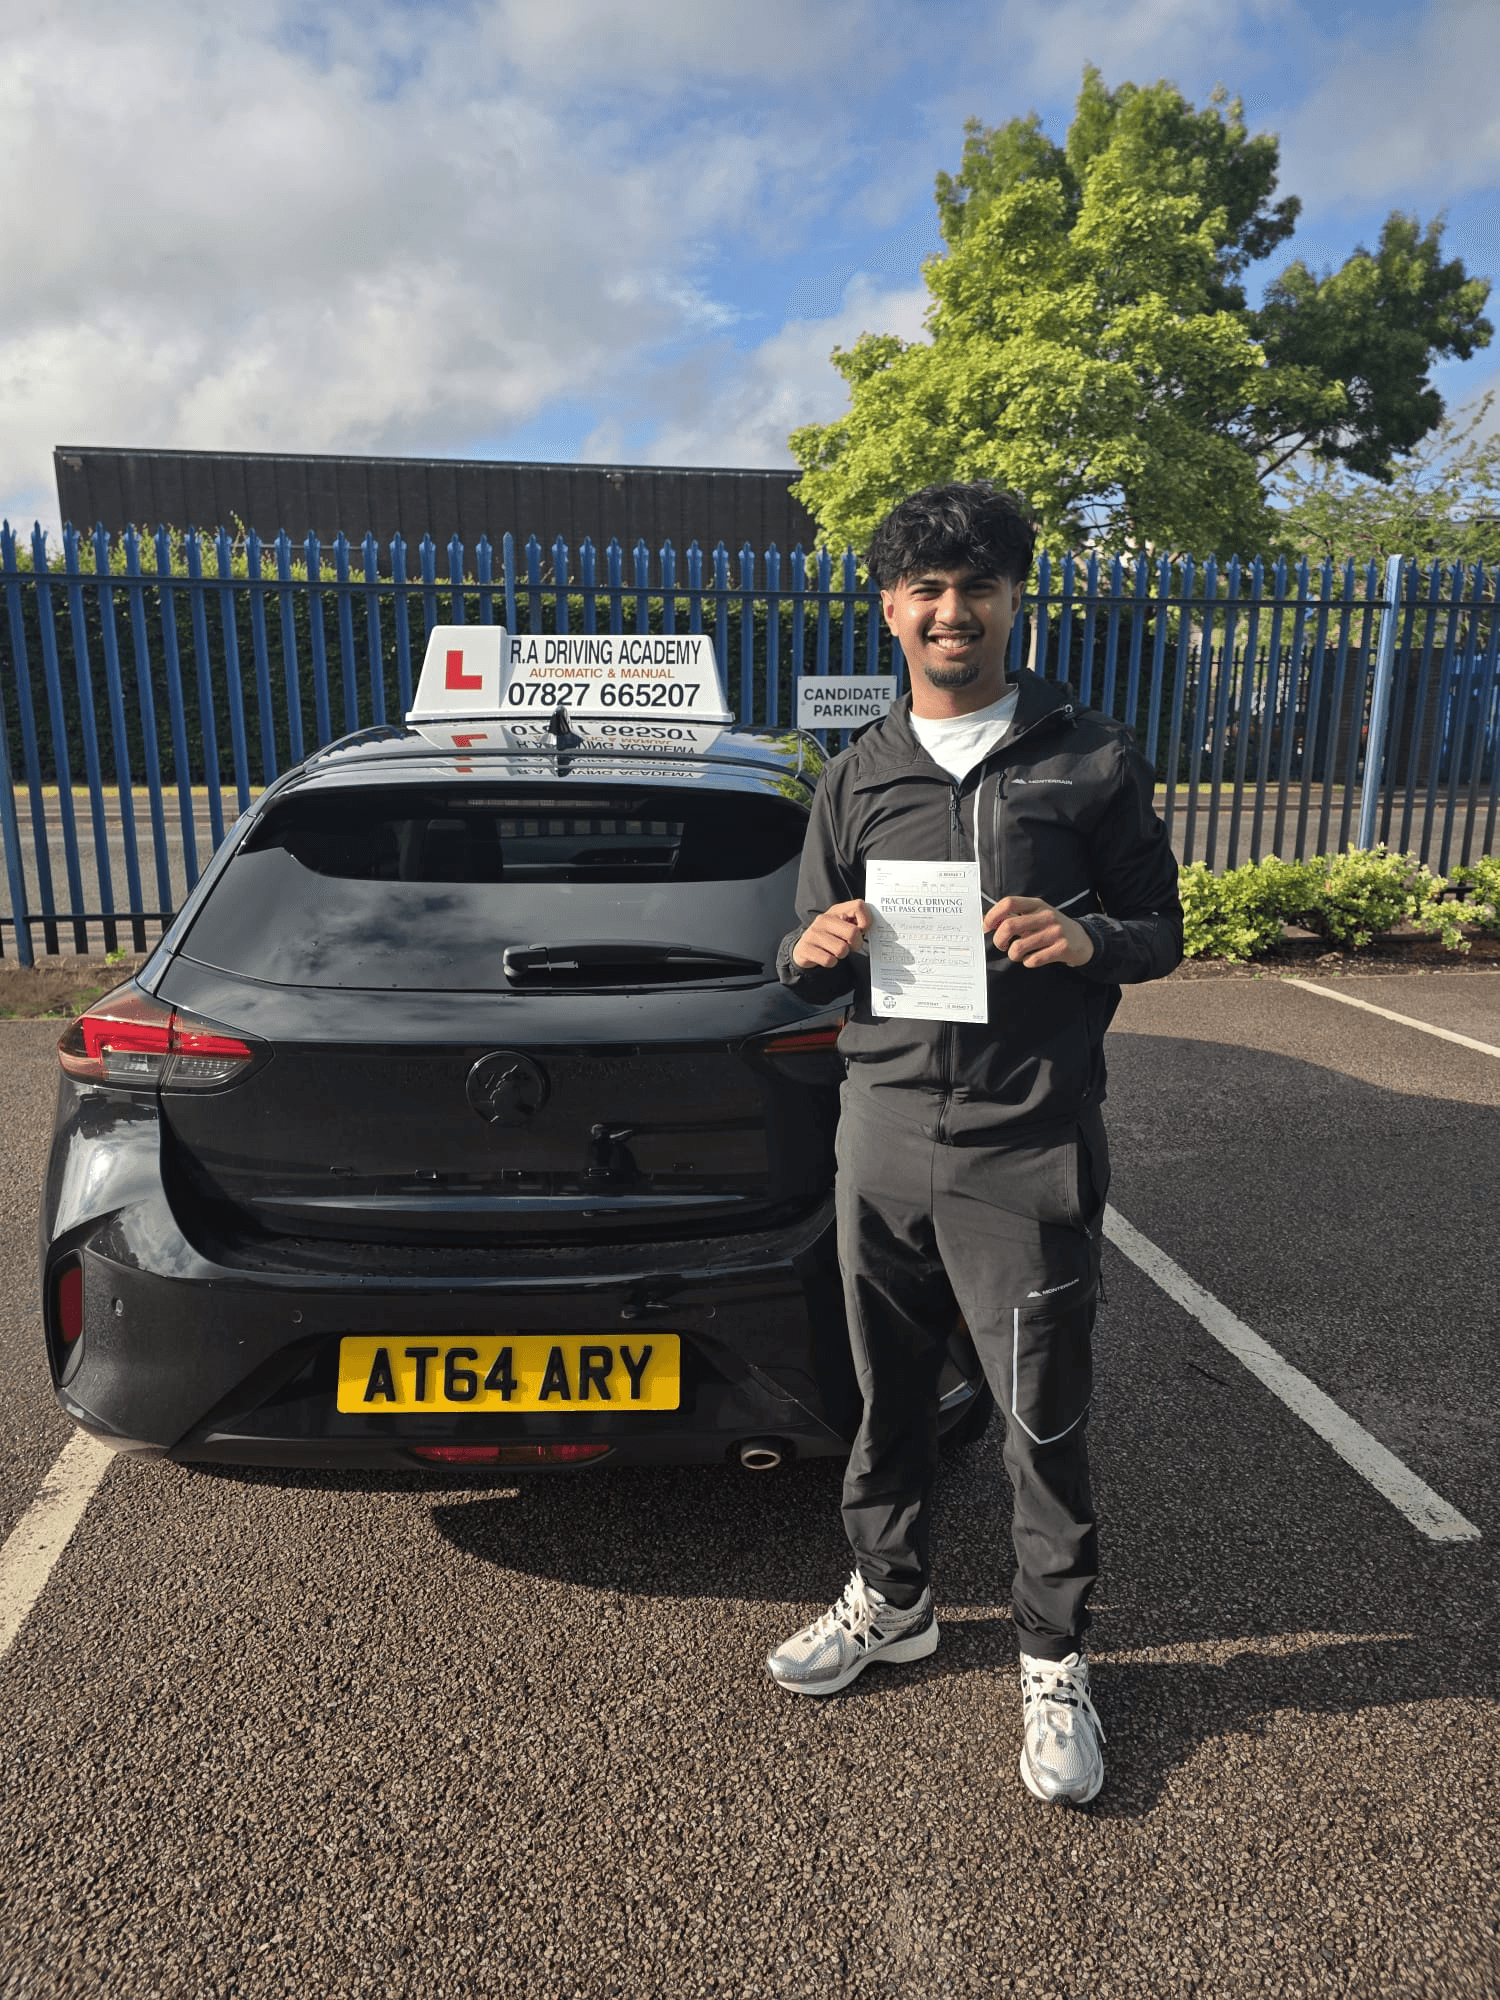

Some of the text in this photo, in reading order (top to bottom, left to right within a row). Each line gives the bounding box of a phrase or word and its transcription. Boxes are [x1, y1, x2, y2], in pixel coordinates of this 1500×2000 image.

[510, 640, 702, 665] R.A DRIVING ACADEMY
[445, 650, 483, 690] L
[529, 668, 676, 679] AUTOMATIC & MANUAL
[508, 683, 701, 707] 07827 665207
[804, 688, 890, 700] CANDIDATE
[814, 704, 881, 716] PARKING
[880, 897, 963, 906] PRACTICAL DRIVING
[917, 906, 963, 914] CERTIFICATE
[363, 1345, 653, 1402] AT64 ARY
